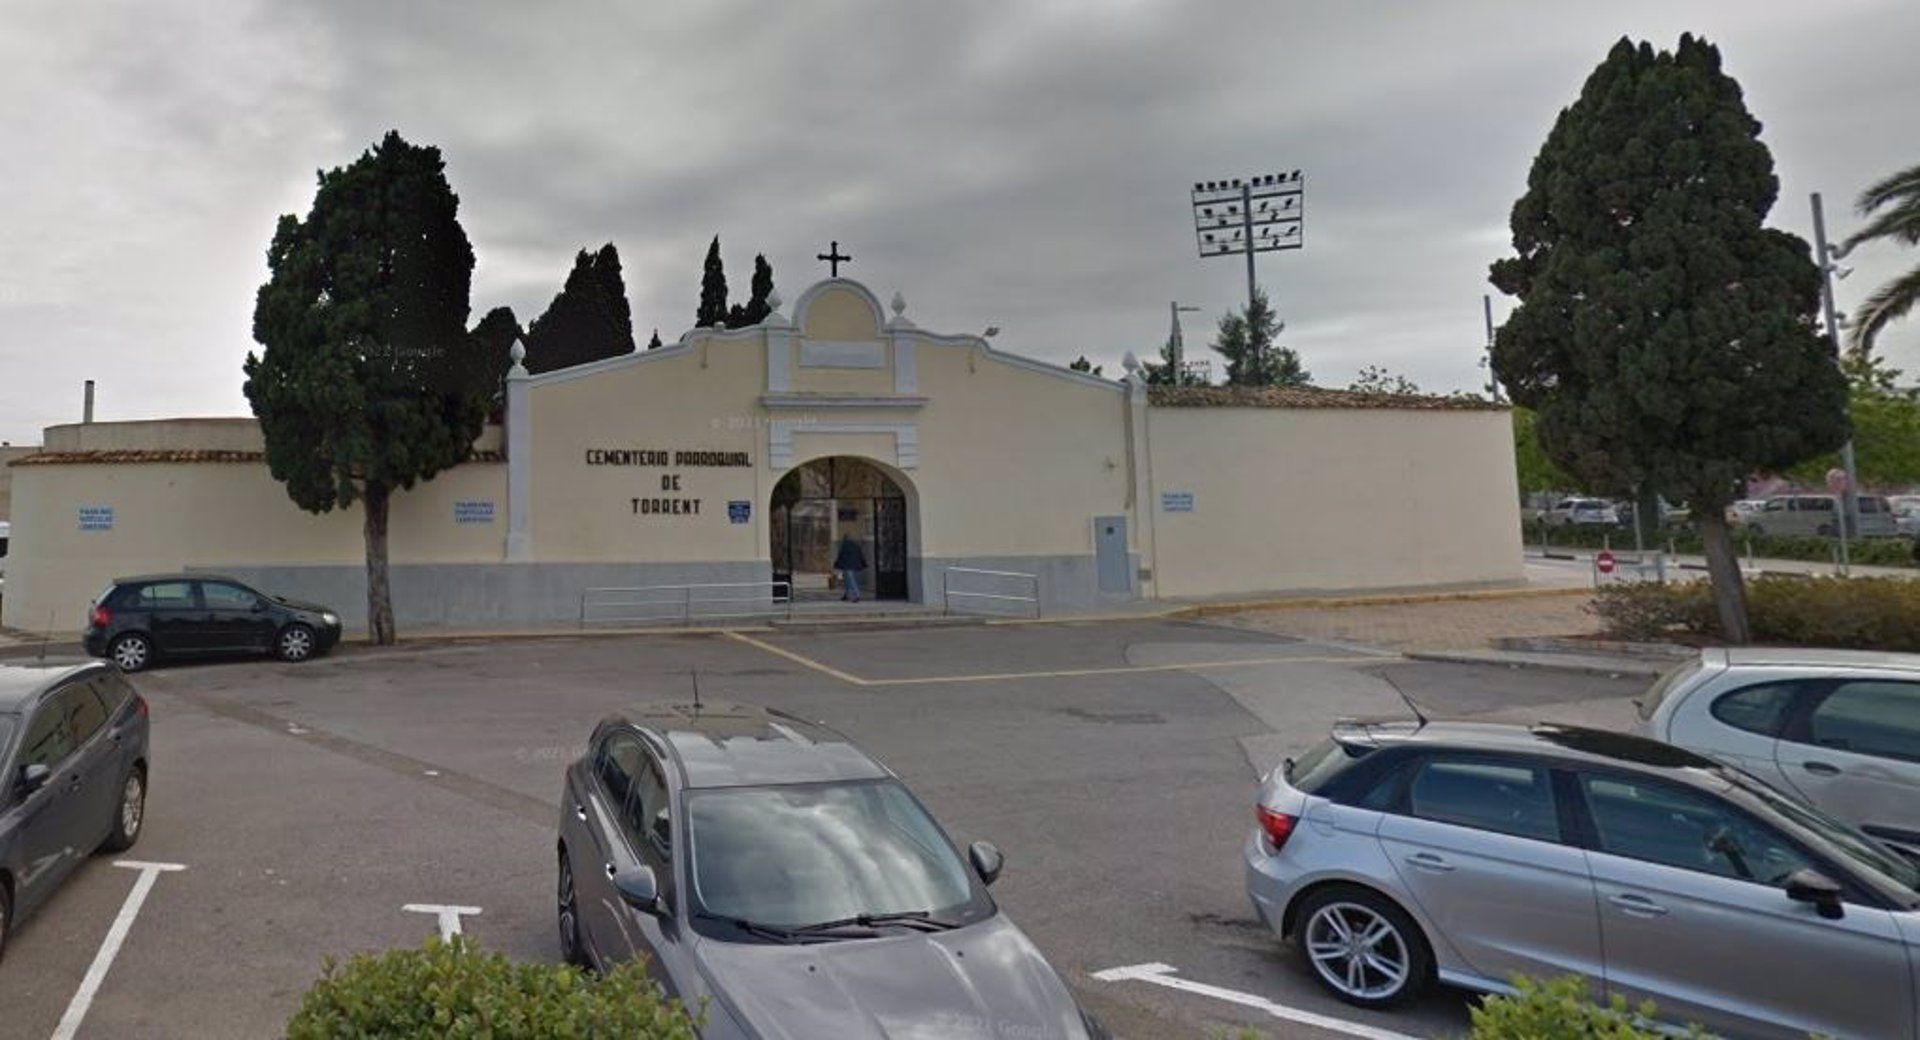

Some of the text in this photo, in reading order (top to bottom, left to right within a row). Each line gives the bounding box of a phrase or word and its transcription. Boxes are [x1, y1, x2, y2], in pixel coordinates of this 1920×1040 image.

[586, 449, 752, 468] CEMENTERIO PARROQUIAL
[661, 474, 682, 491] DE
[631, 498, 701, 515] TORRENT
